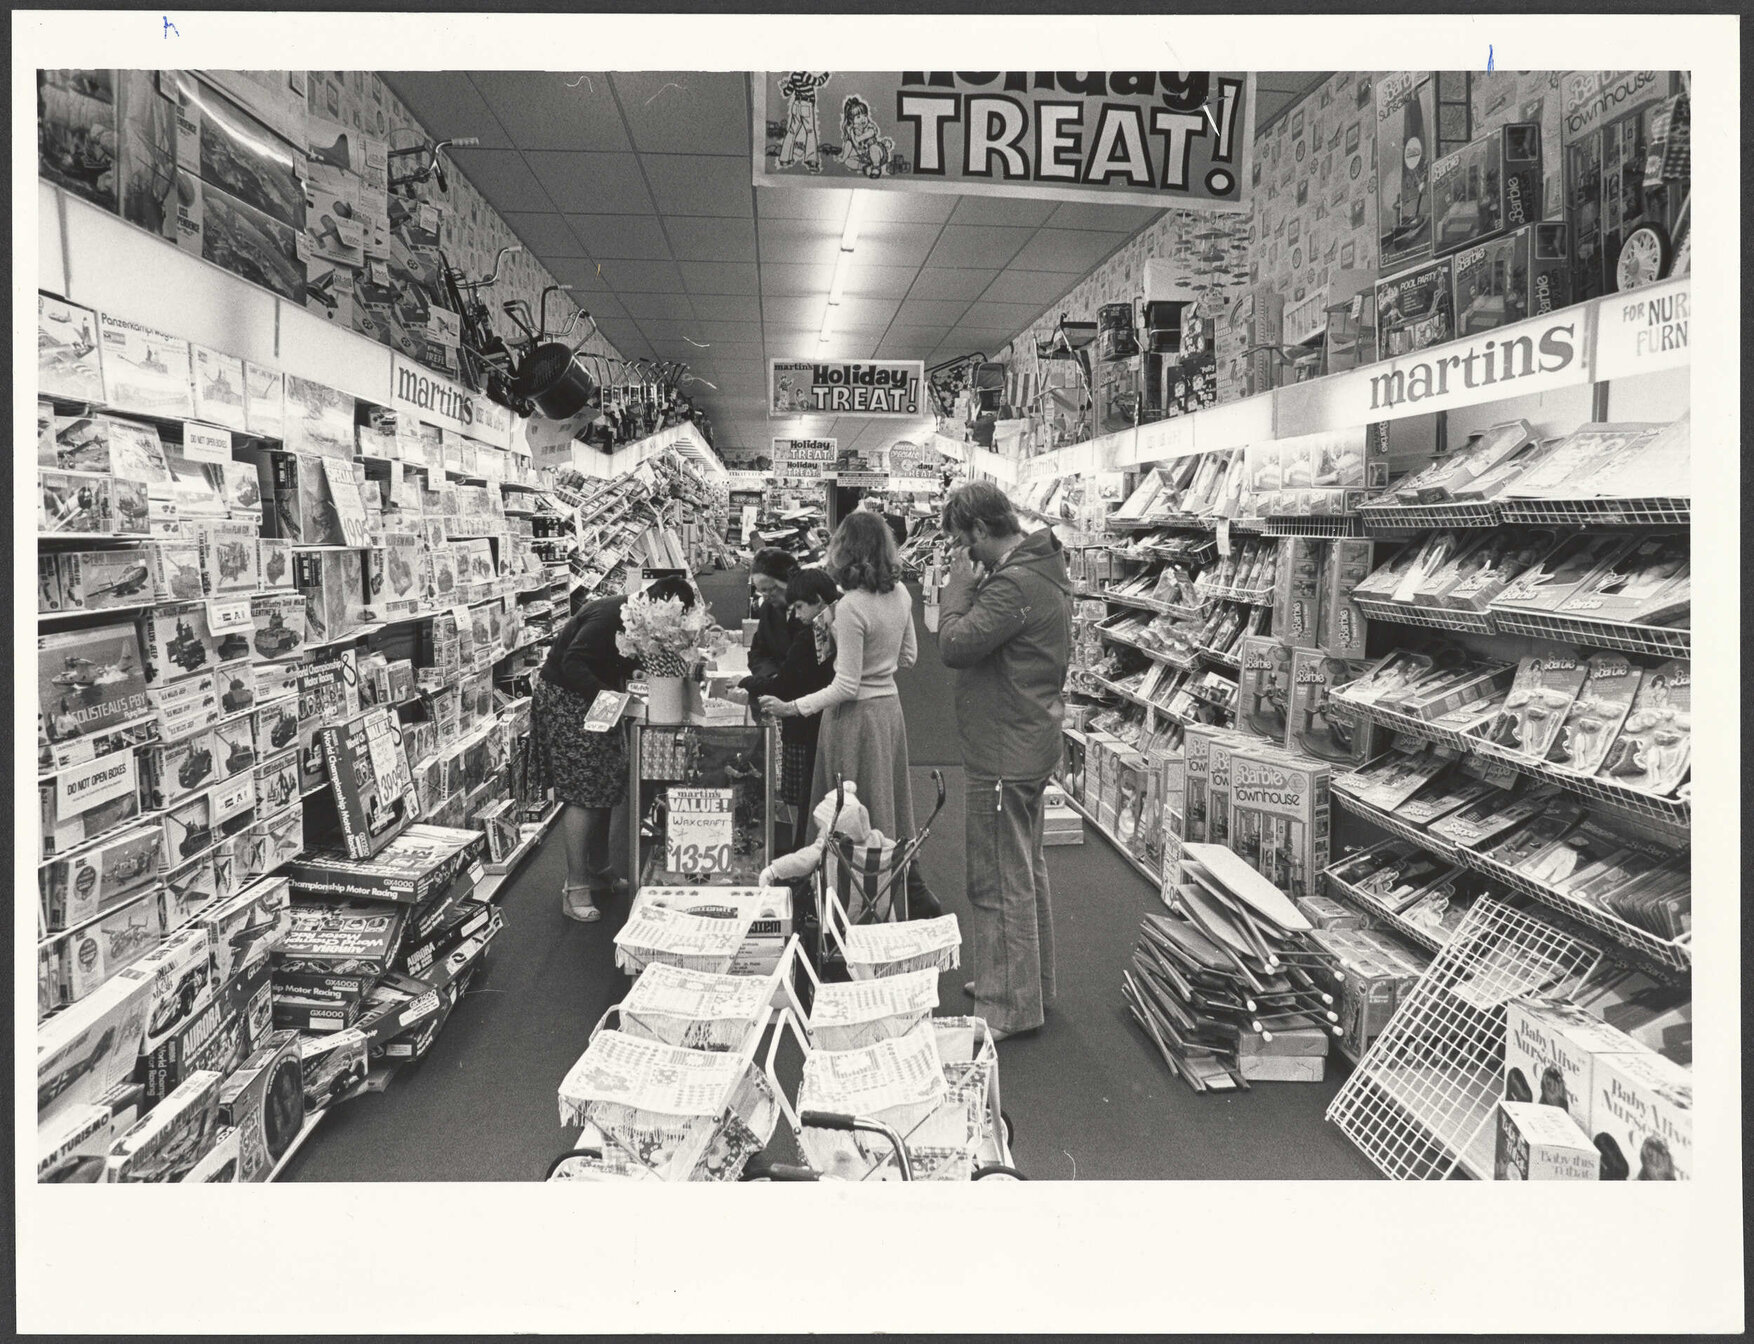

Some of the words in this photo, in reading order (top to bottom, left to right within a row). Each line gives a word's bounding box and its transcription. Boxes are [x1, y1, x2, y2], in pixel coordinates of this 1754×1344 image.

[1564, 71, 1656, 135] Townhouse
[898, 79, 1242, 196] TREAT!
[1508, 177, 1524, 224] Barbie
[1400, 278, 1417, 293] POOL
[1417, 271, 1438, 286] PARTY
[1536, 275, 1551, 317] Barbie
[1623, 301, 1645, 323] FOR
[1636, 328, 1689, 357] FURN
[813, 364, 908, 388] Holiday
[1369, 323, 1575, 411] martins
[398, 366, 474, 426] martins
[811, 378, 919, 413] TREAT!
[790, 439, 830, 451] Holiday
[791, 449, 835, 461] TREAT!
[1290, 602, 1304, 637] Barbie
[1340, 610, 1352, 649] Barbie
[309, 658, 343, 674] Championship
[1246, 658, 1272, 669] Barbie
[1544, 656, 1578, 671] Barbie
[1594, 663, 1628, 678] Barbie
[304, 676, 319, 689] Motor
[319, 671, 334, 684] Racing
[1296, 671, 1325, 683] Barbie
[129, 691, 145, 708] PBY
[323, 730, 335, 755] World
[67, 782, 77, 795] DO
[77, 777, 91, 791] NOT
[91, 770, 108, 785] OPEN
[108, 763, 127, 780] BOXES
[328, 754, 348, 811] Championship
[1235, 764, 1285, 786] Barbie
[670, 798, 728, 813] VALUE!
[1233, 785, 1301, 806] Townhouse
[339, 810, 352, 834] Motor
[349, 834, 359, 860] Racing
[287, 877, 346, 893] Championship
[346, 884, 378, 895] Motor
[379, 886, 398, 898] Racing
[383, 878, 414, 887] GX4000
[291, 932, 317, 941] Rac
[407, 942, 436, 968] AURORA
[285, 985, 318, 994] Motor
[319, 987, 341, 998] Racing
[325, 978, 358, 988] GX4000
[310, 1009, 344, 1018] GX4000
[182, 1000, 221, 1061] AURORA
[147, 1070, 156, 1096] Racing
[60, 1113, 109, 1157] TURISMO
